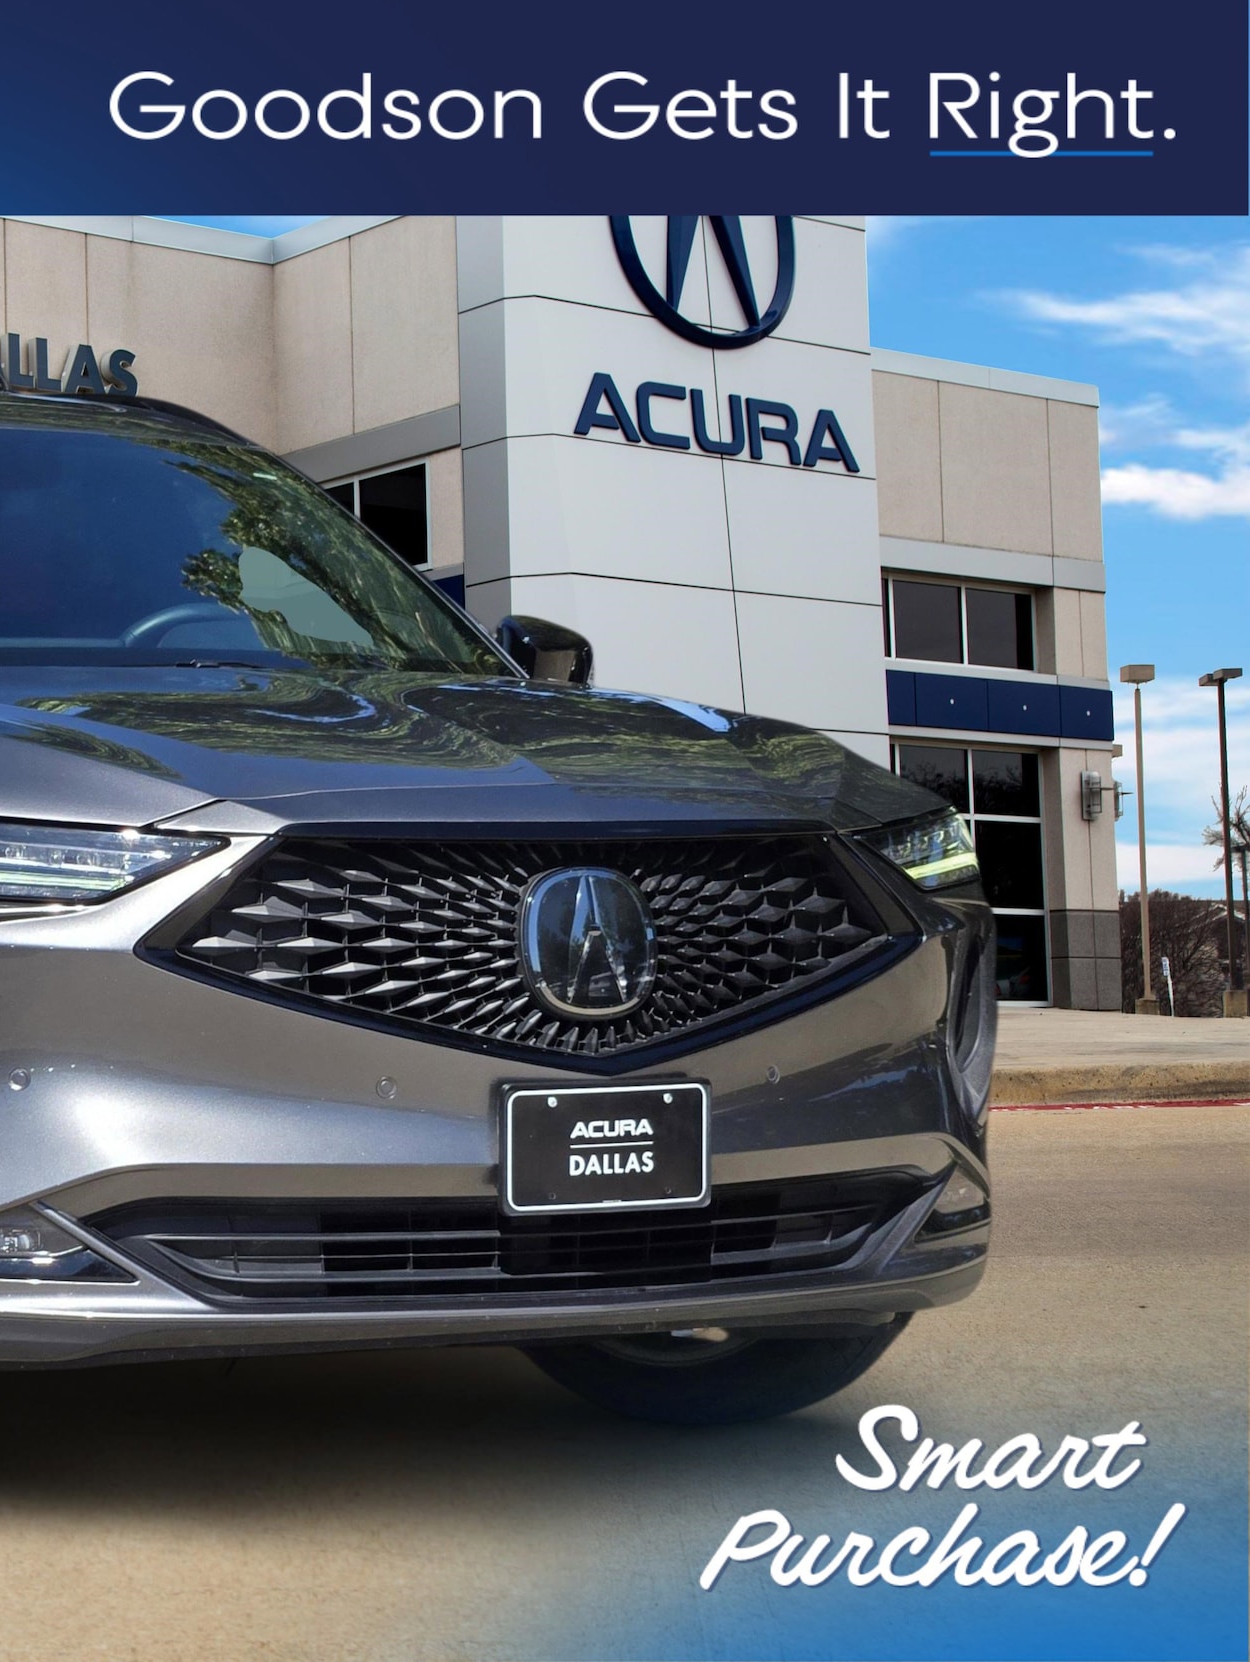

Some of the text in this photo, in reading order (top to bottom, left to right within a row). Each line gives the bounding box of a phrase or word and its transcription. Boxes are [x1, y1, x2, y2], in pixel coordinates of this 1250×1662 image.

[574, 371, 861, 473] ACURA
[570, 1118, 654, 1139] ACURA
[569, 1151, 654, 1177] DALLAS
